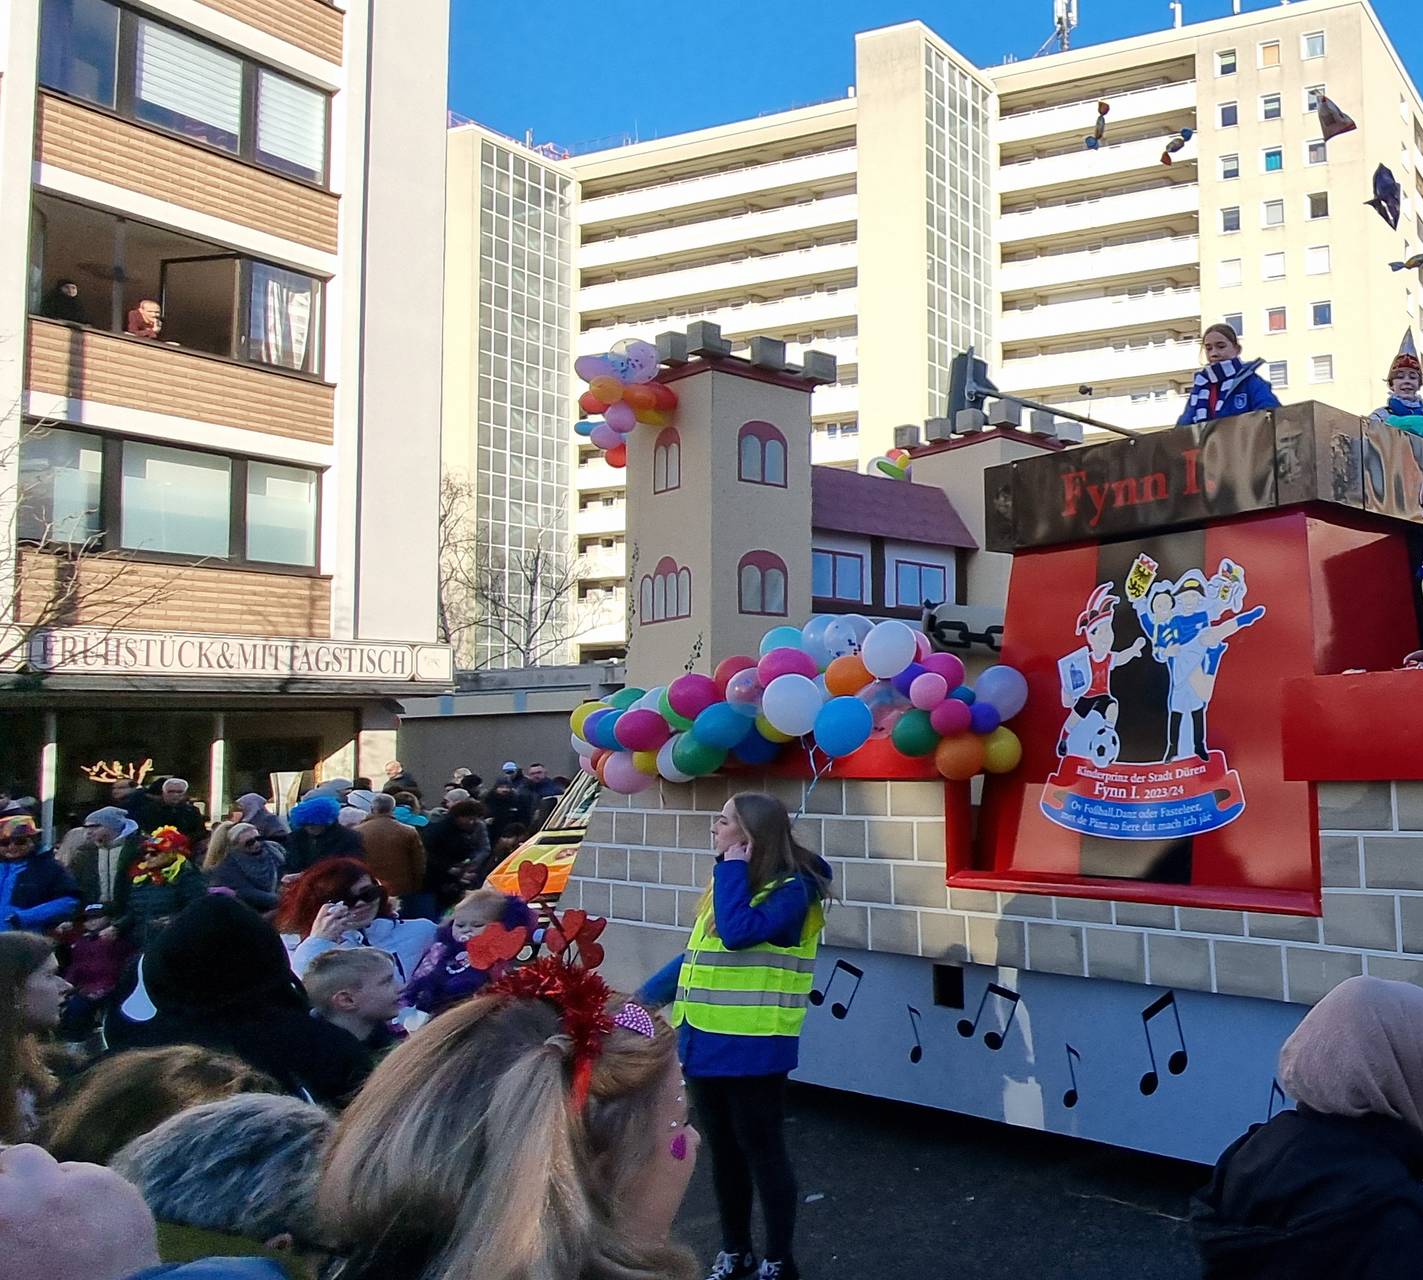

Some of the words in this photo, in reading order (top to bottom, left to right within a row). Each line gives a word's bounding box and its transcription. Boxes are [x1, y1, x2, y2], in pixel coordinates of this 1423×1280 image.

[1060, 469, 1169, 527] Fynn
[1181, 448, 1216, 495] I.
[41, 631, 406, 675] FRÜHSTÜCK&MITTAGSTISCH
[1076, 766, 1129, 783] Kinderprinz
[1130, 773, 1147, 783] der
[1148, 770, 1174, 783] Stadt
[1175, 765, 1207, 779] Düren
[1094, 782, 1126, 801] Fynn
[1130, 786, 1140, 799] I.
[1144, 785, 1184, 799] 2023/24
[1138, 809, 1158, 819] oder
[1157, 818, 1182, 831] mach
[1183, 815, 1197, 827] ich
